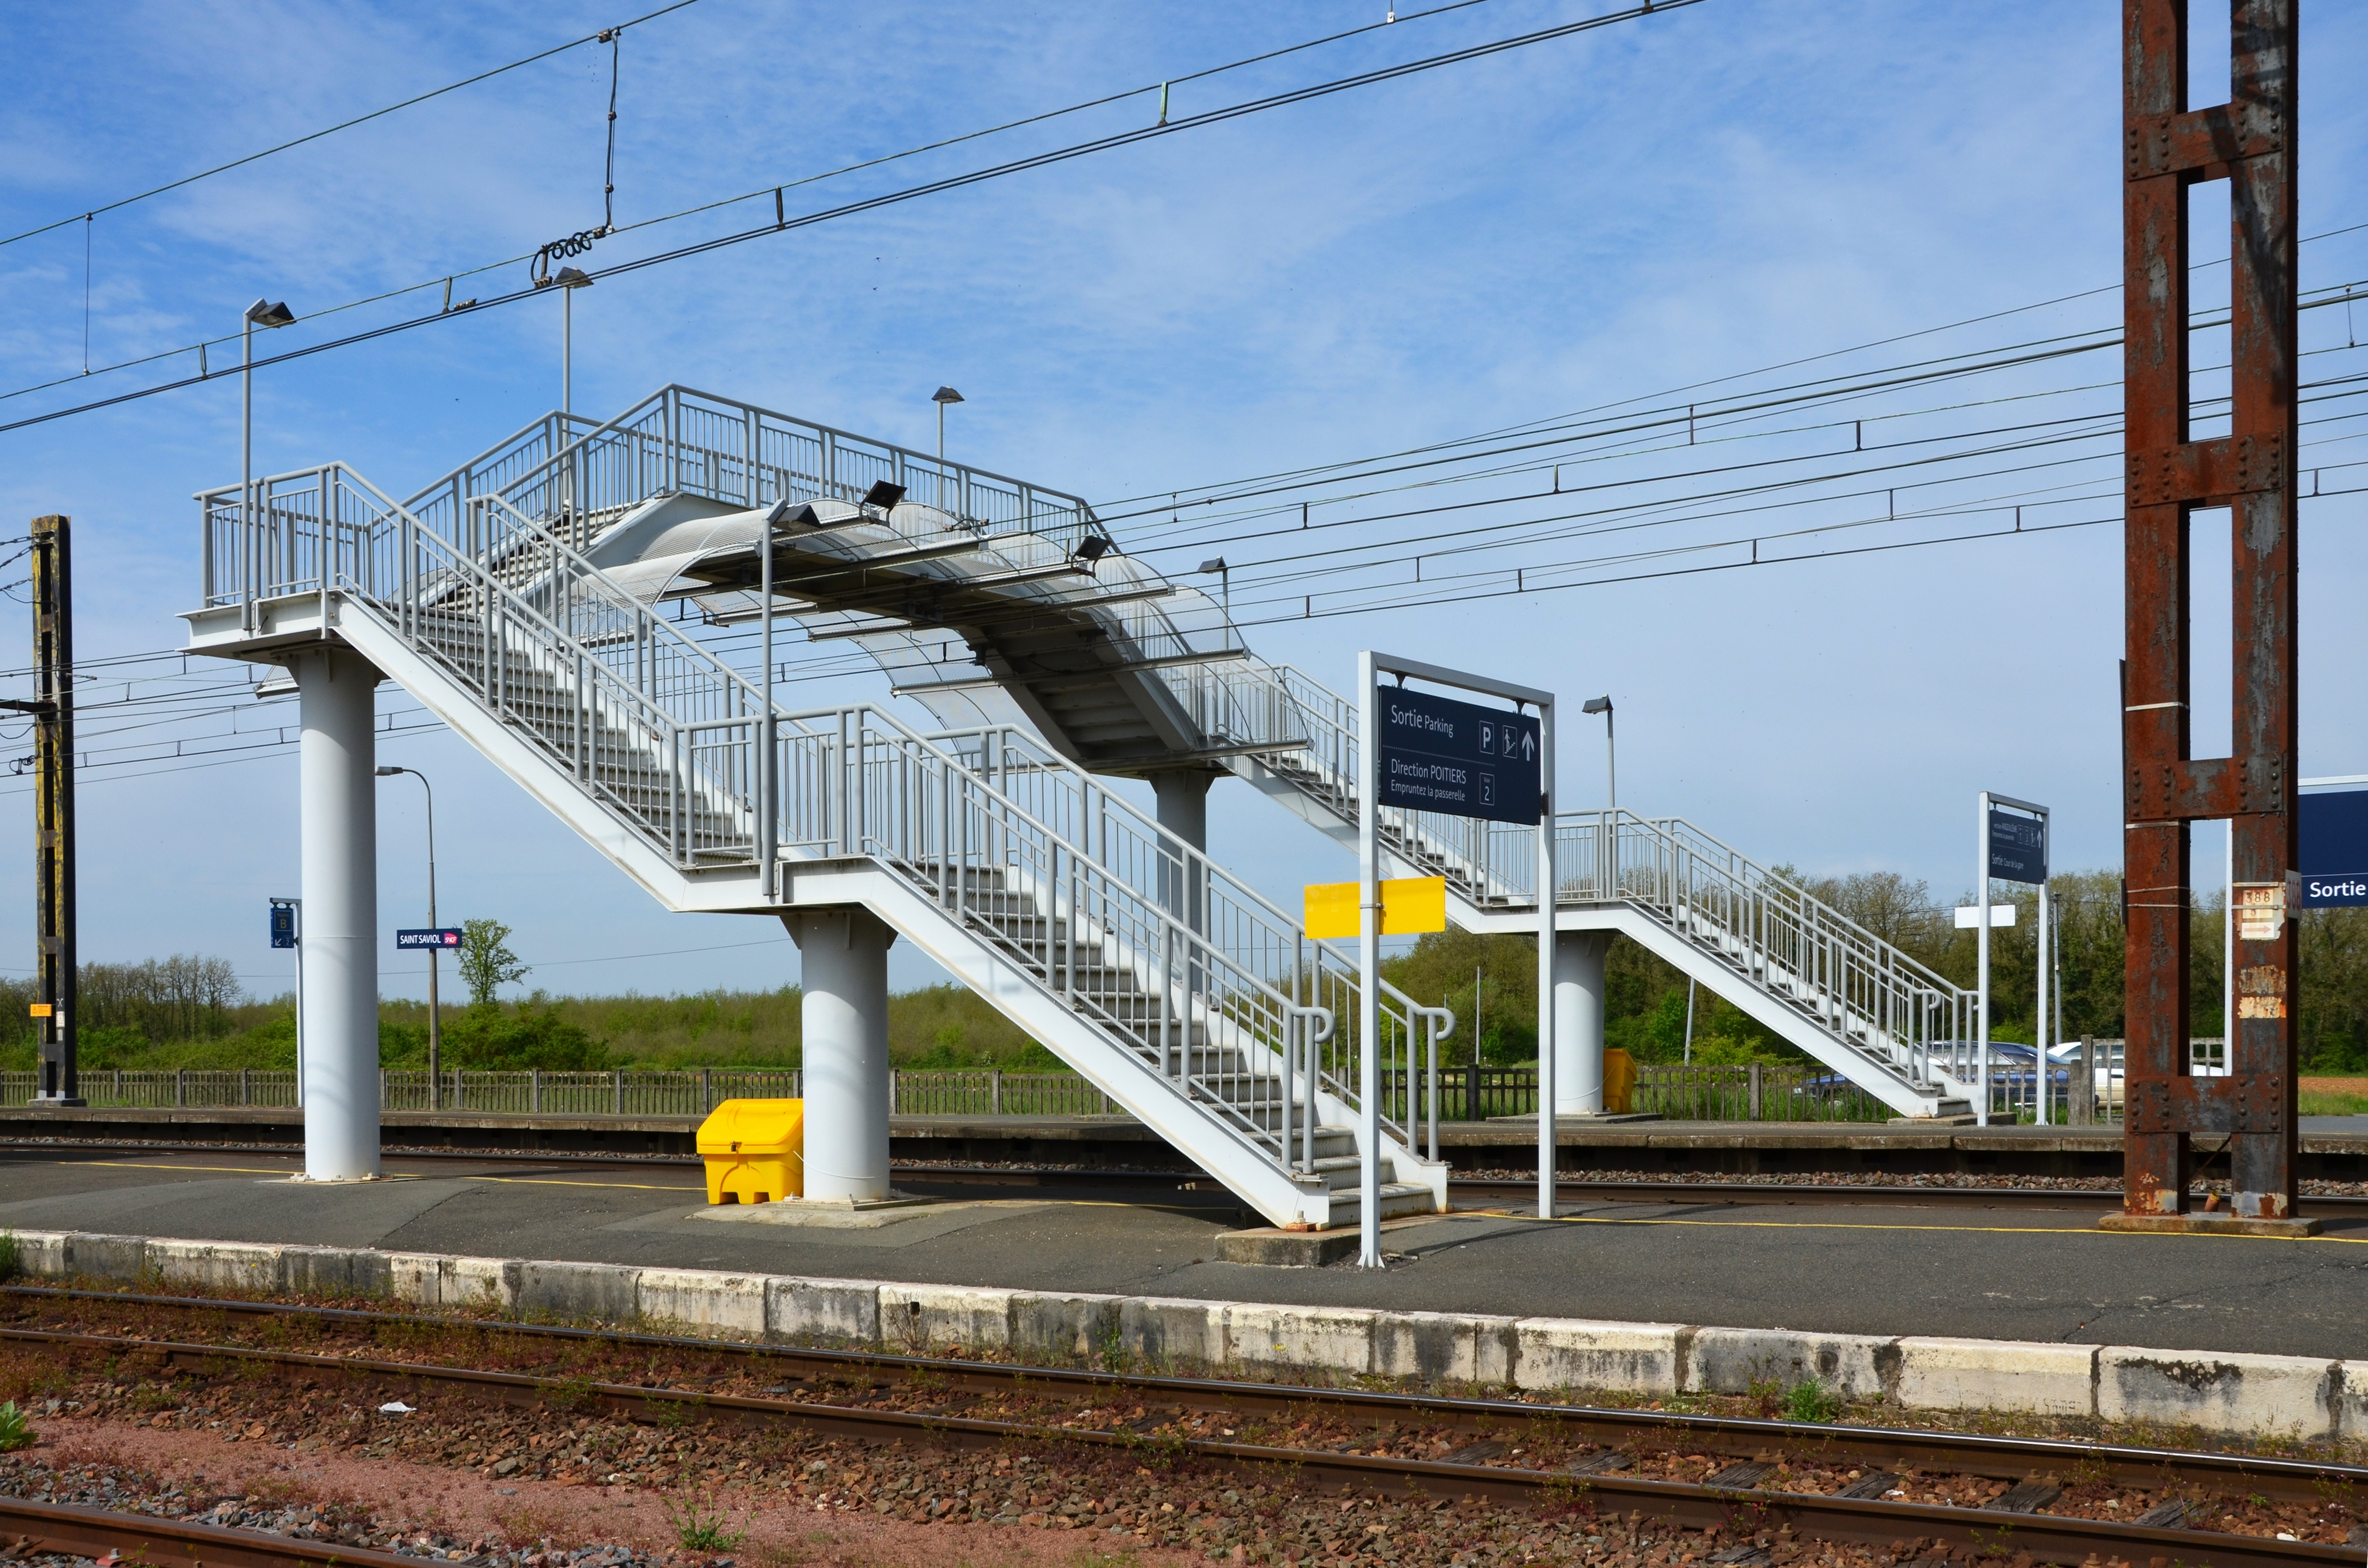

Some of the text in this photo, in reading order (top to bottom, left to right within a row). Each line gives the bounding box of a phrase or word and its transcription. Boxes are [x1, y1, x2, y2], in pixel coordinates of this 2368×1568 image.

[1391, 704, 1454, 738] Sortie Parking
[1483, 726, 1492, 748] P
[1391, 759, 1467, 784] Direction POITIERS
[1391, 779, 1465, 801] Empruntez la passerelle
[1484, 786, 1490, 801] 2
[1992, 853, 2003, 866] Sortie
[2310, 881, 2366, 897] Sortie
[2245, 892, 2270, 903] 388
[280, 919, 287, 929] B
[400, 935, 418, 944] SAINT
[419, 934, 441, 944] SAVIOL
